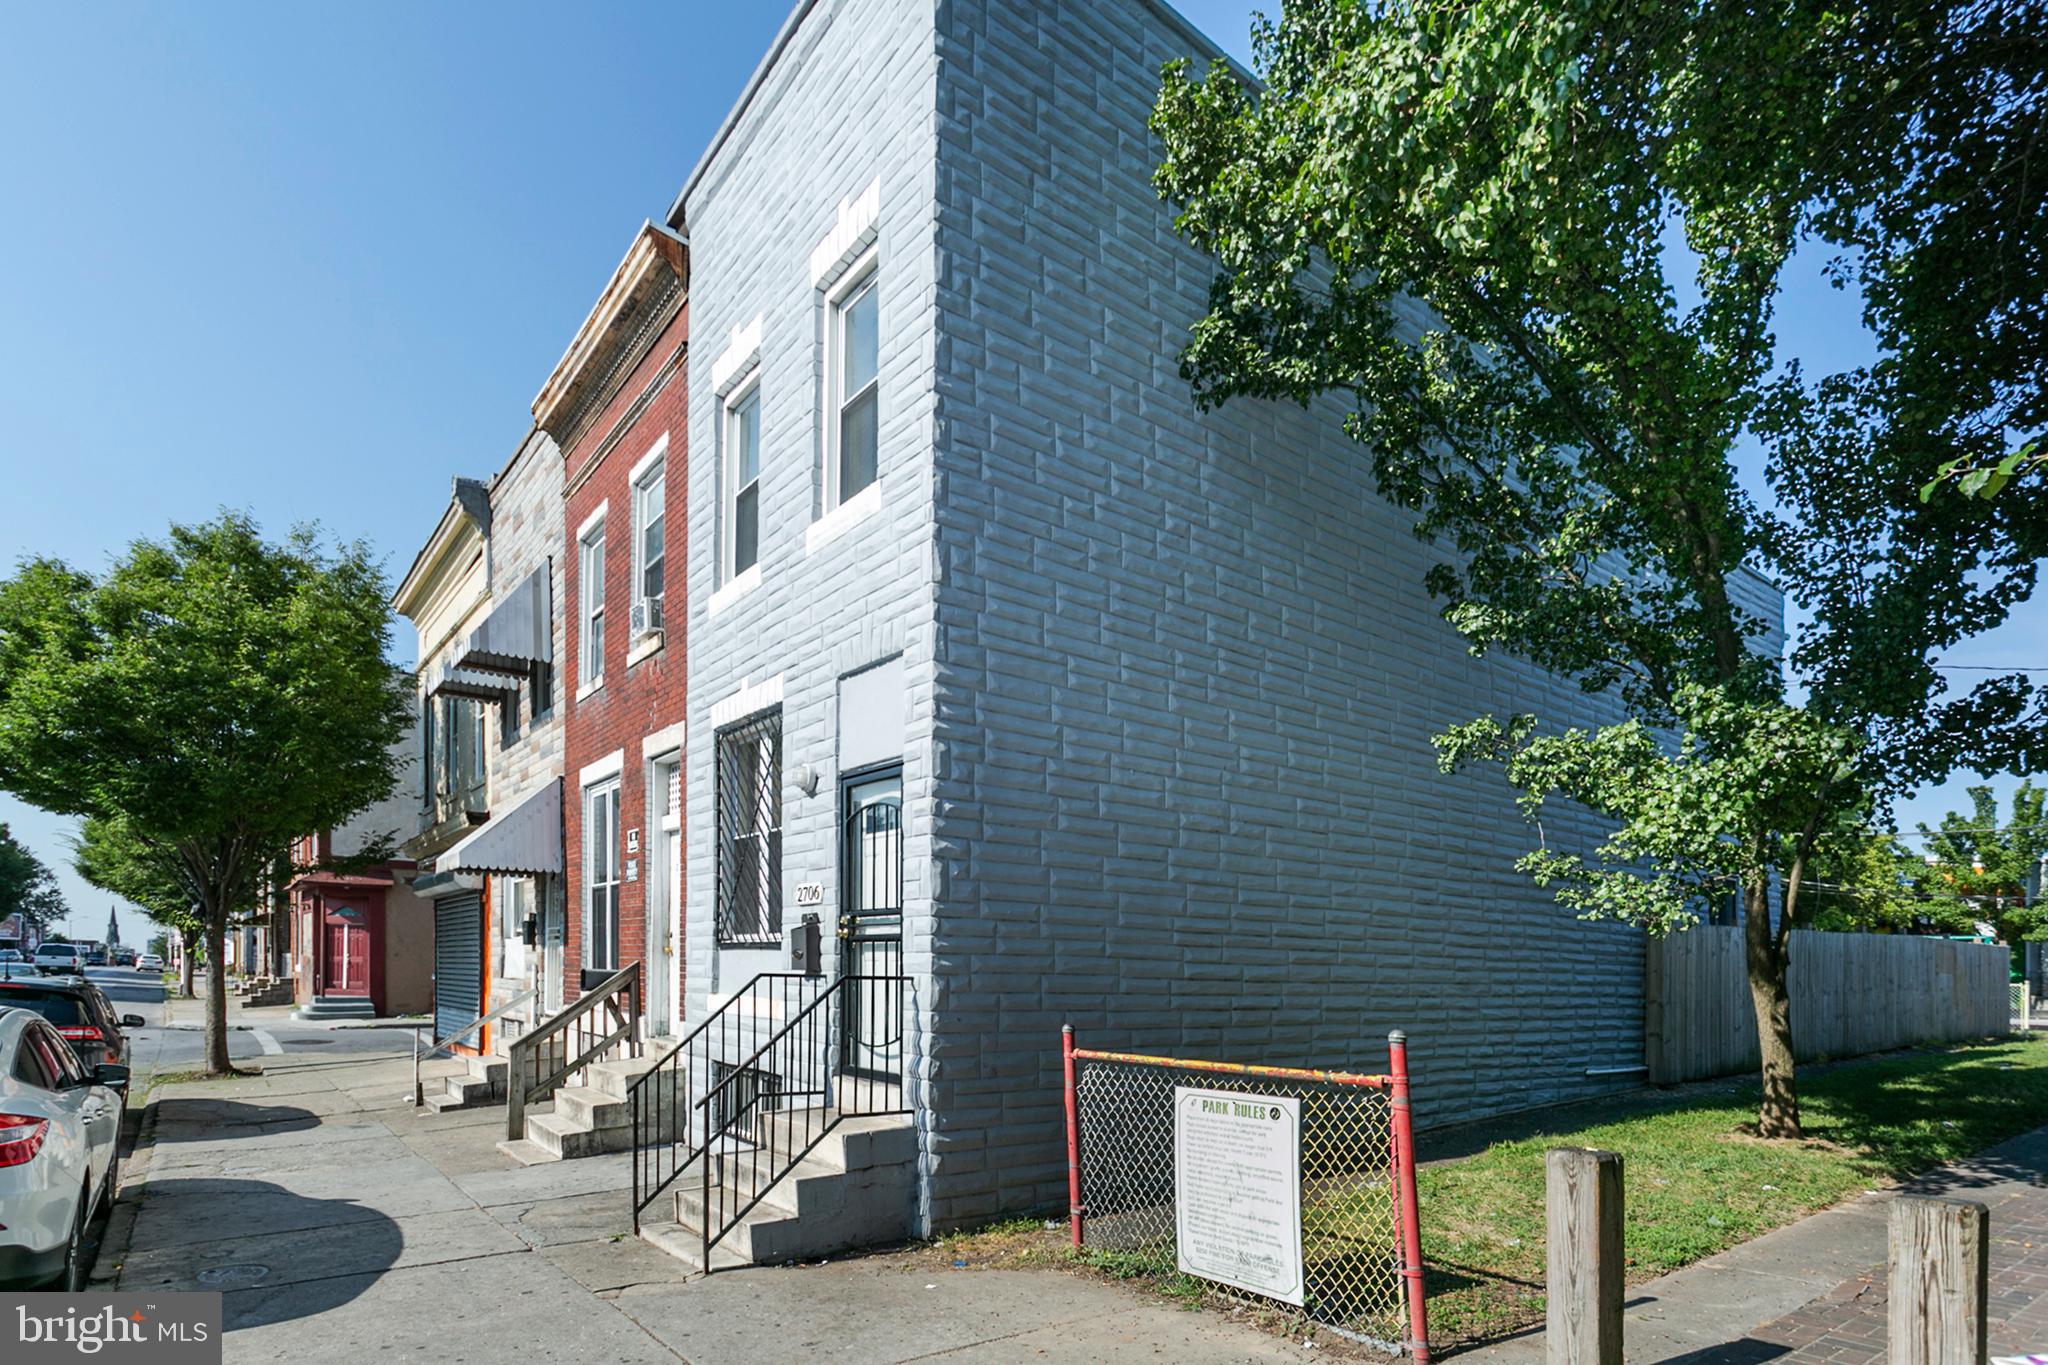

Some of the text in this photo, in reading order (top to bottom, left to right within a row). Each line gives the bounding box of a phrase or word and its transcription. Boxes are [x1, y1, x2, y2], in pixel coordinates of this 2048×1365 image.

[797, 885, 820, 902] 2706
[1202, 1100, 1266, 1120] PARK RULES
